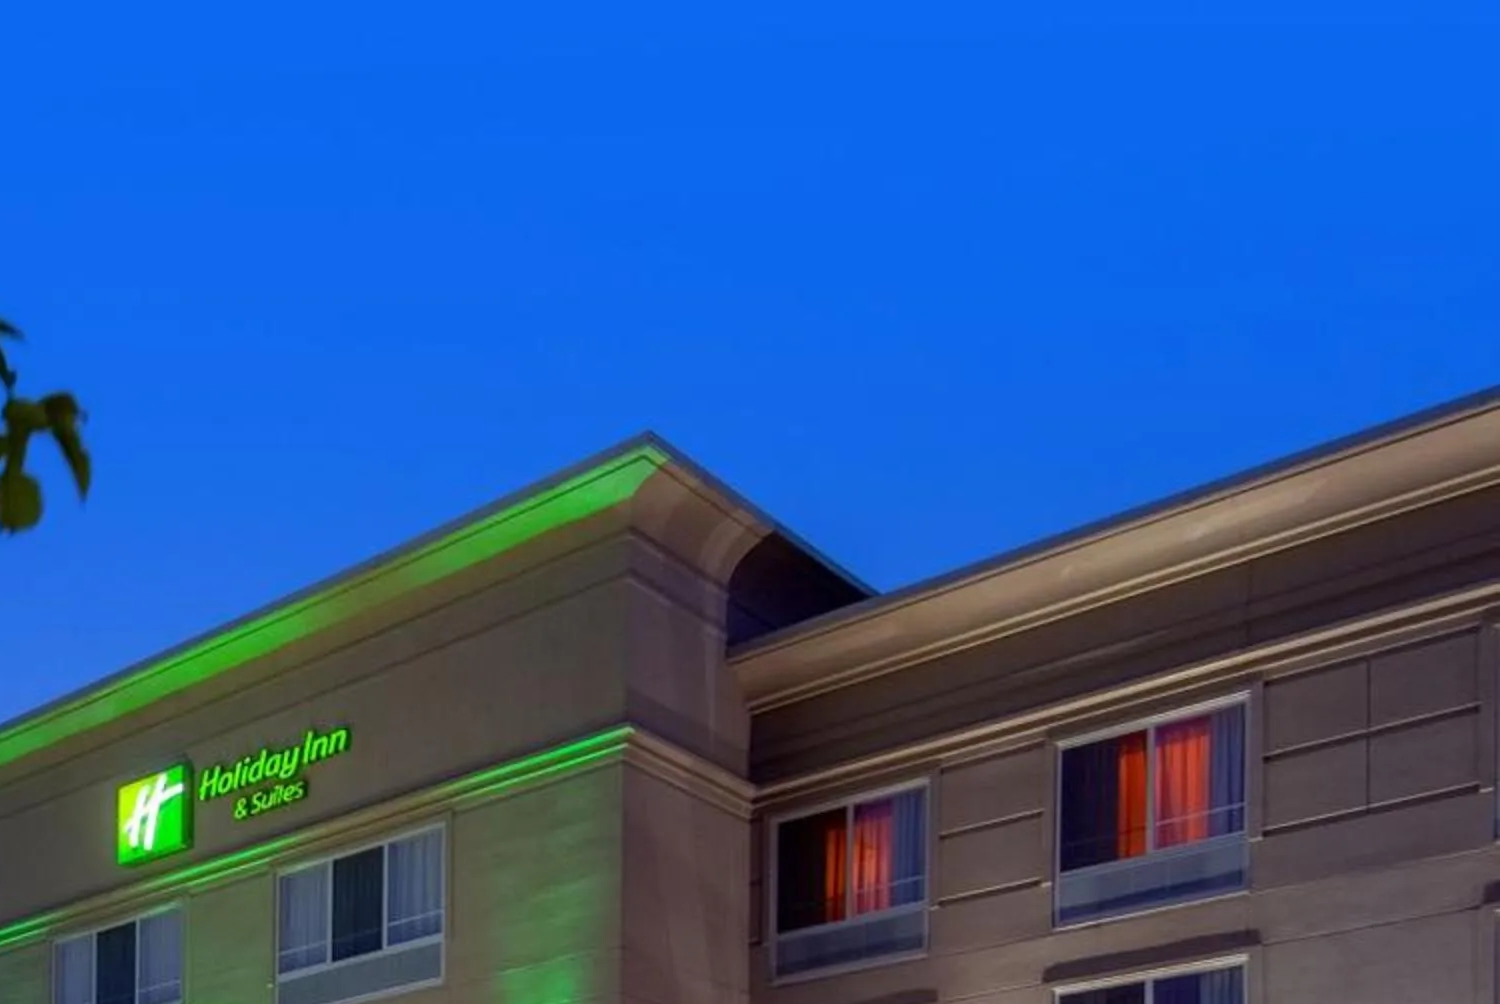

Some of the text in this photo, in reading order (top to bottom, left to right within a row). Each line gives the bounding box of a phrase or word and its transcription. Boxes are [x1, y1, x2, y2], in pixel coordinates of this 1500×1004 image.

[199, 730, 347, 801] Holiday Inn
[233, 781, 304, 819] & Suites
